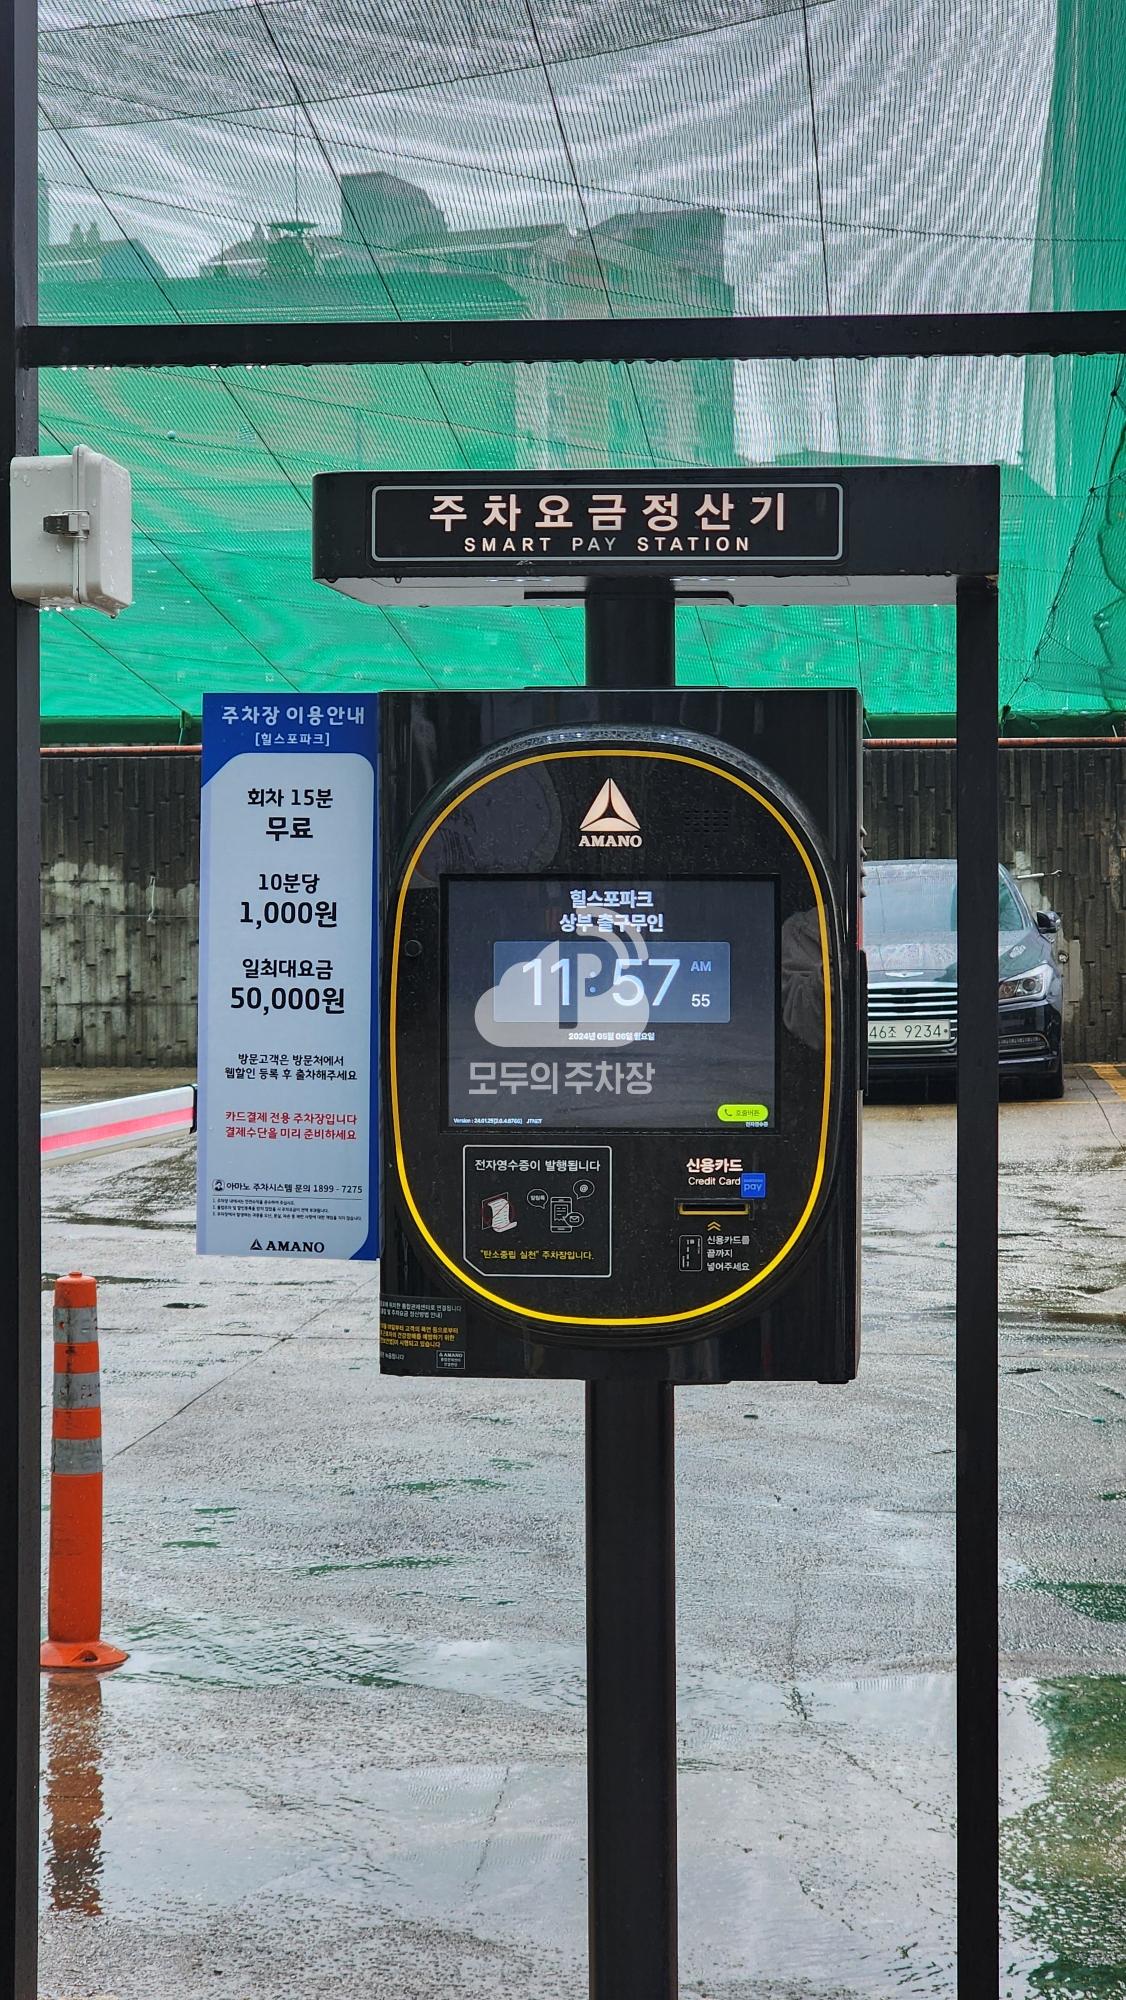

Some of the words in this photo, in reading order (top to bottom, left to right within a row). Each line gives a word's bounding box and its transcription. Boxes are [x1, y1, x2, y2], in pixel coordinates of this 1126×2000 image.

[429, 492, 785, 532] 주차요금정산기
[464, 536, 552, 552] SMART
[571, 537, 616, 552] PAY
[637, 537, 750, 552] STATION
[222, 706, 280, 725] 주차장
[286, 706, 365, 726] 이용안내
[255, 732, 330, 746] [힐스포파크]
[247, 788, 284, 807] 회차
[291, 789, 333, 808] 15분
[266, 817, 313, 841] 무료
[578, 835, 643, 847] AMANO
[259, 873, 320, 894] 10분당
[570, 889, 654, 909] 힐스포파크
[240, 901, 337, 929] 1,000원
[560, 913, 593, 932] 상부
[596, 913, 664, 933] 출구무인
[242, 958, 333, 980] 일최대요금
[522, 958, 681, 1006] 11:57
[690, 960, 712, 972] AM
[231, 987, 345, 1015] 50,000원
[691, 994, 710, 1007] 55
[568, 1032, 596, 1041] 2024년
[869, 1025, 897, 1039] 46조
[905, 1025, 941, 1038] 9234
[238, 1053, 289, 1066] 방문고객은
[292, 1055, 344, 1067] 방문처에서
[224, 1067, 255, 1080] 웹할인
[258, 1068, 279, 1080] 등록
[282, 1069, 292, 1080] 후
[295, 1069, 358, 1081] 출차해주세요
[225, 1111, 267, 1123] 카드결제
[270, 1113, 290, 1124] 전용
[293, 1113, 357, 1126] 주차장입니다
[225, 1127, 277, 1140] 결제수단을
[281, 1128, 300, 1139] 미리
[304, 1128, 357, 1140] 준비하세요
[474, 1159, 540, 1172] 전자영수증이
[545, 1160, 601, 1172] 발행됩니다
[686, 1158, 743, 1173] 신용카드
[226, 1182, 250, 1191] 아마노
[253, 1183, 293, 1193] 주차시스템
[295, 1184, 311, 1193] 문의
[313, 1184, 334, 1193] 1899
[342, 1185, 363, 1194] 7275
[688, 1177, 716, 1185] Credit
[718, 1177, 741, 1185] Card
[744, 1184, 762, 1192] pay
[266, 1240, 325, 1253] AMANO
[707, 1235, 750, 1245] 신용카드를
[542, 1251, 594, 1261] 주차장입니다.
[707, 1249, 733, 1258] 끝까지
[707, 1262, 750, 1272] 넣어주세요
